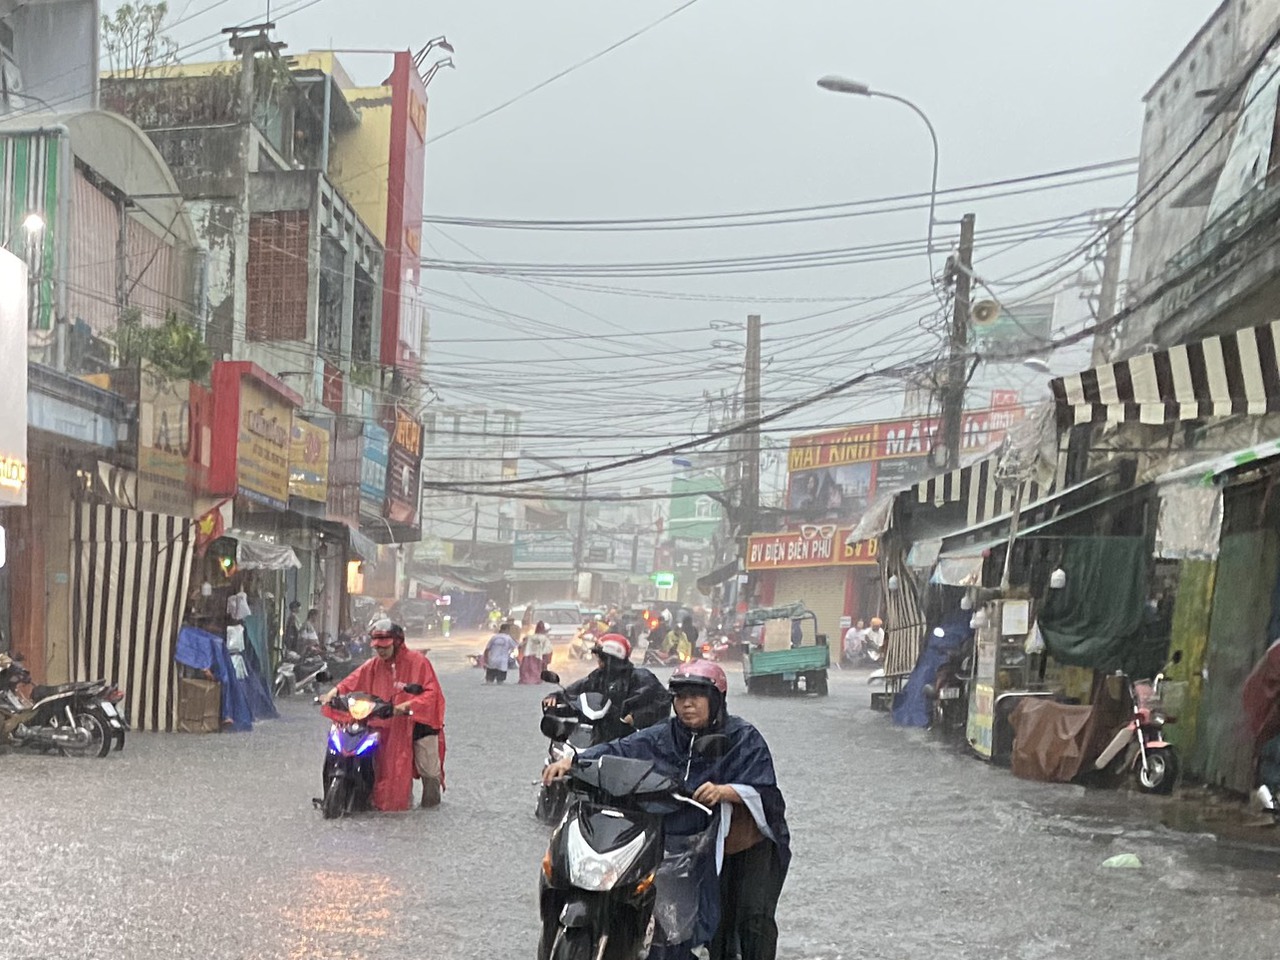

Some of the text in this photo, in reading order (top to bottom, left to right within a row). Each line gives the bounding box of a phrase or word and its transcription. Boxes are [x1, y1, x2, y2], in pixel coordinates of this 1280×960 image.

[829, 432, 871, 463] KÍNH
[751, 544, 763, 562] BV
[766, 539, 785, 565] ĐIỆN
[788, 538, 808, 560] BIÊN
